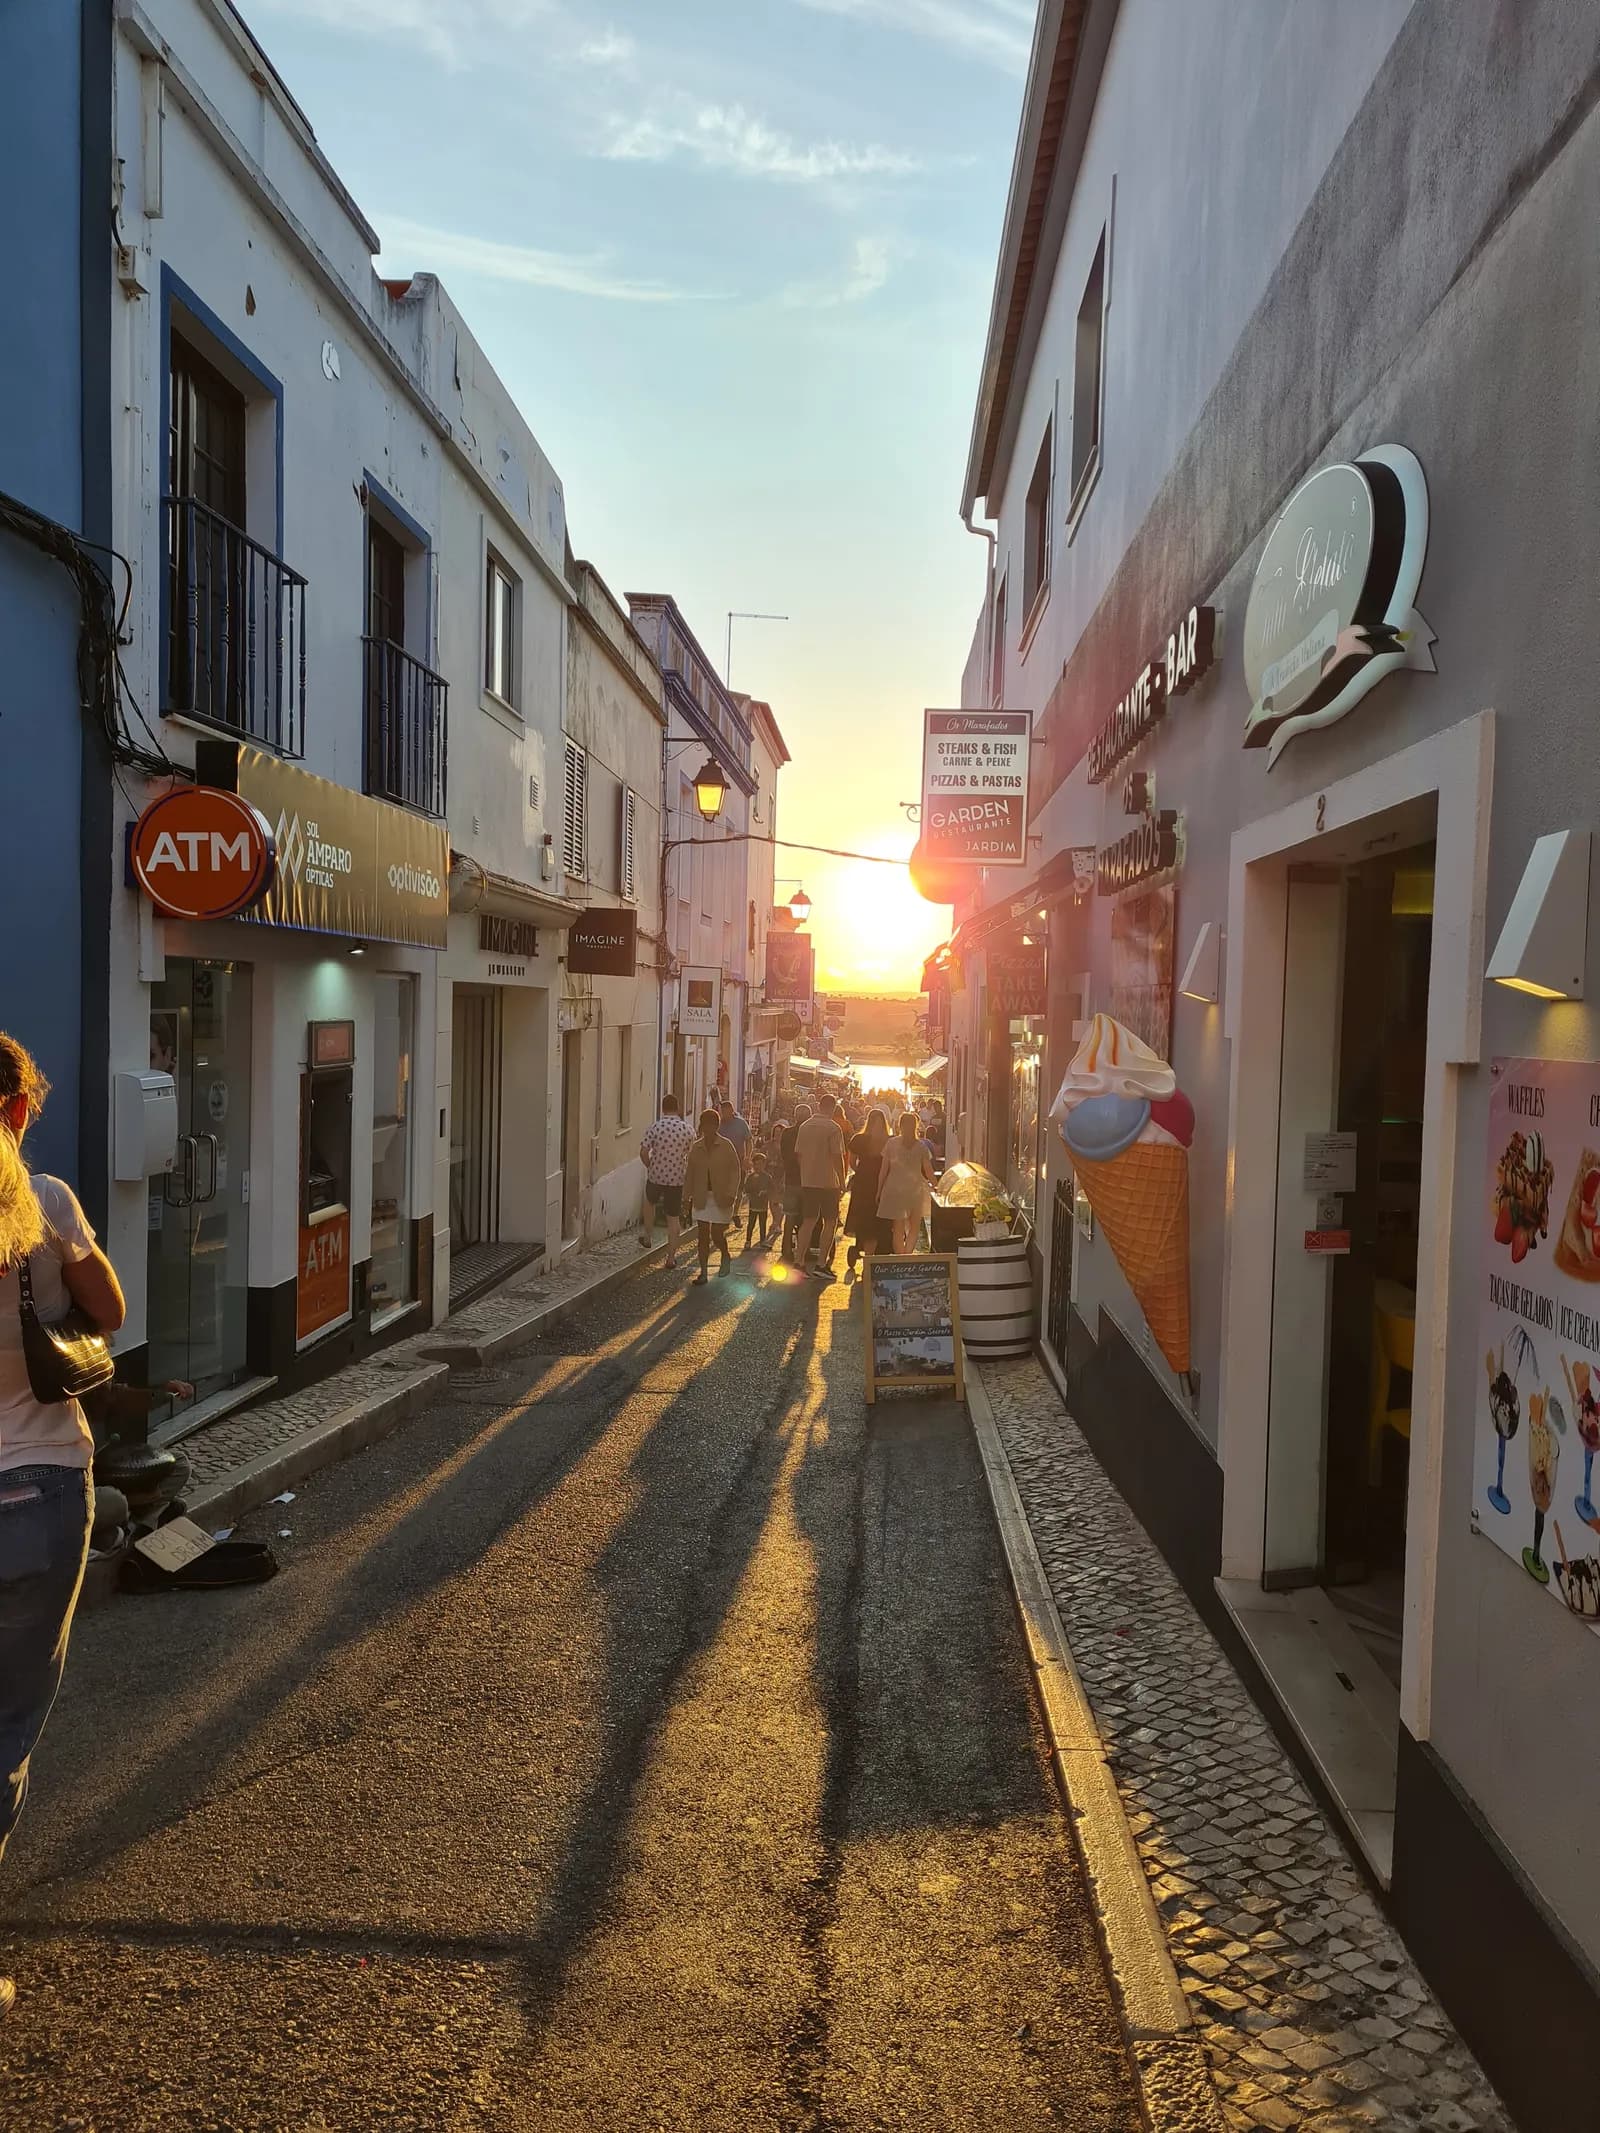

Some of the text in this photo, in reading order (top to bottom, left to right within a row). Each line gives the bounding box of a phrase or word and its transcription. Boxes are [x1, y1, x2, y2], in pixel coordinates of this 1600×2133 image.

[1088, 605, 1200, 781] RESTAURANTE BAR
[937, 743, 1017, 756] STEAKS & FISH
[942, 757, 1012, 767] CARNE & PEIXE
[930, 774, 1022, 788] PIZZAS & PASTAS
[931, 799, 1010, 829] GARDEN
[306, 820, 320, 839] SOL
[145, 831, 250, 872] ATM
[306, 839, 352, 875] AMPARO
[964, 840, 1017, 853] JARDIM
[305, 864, 334, 889] ÓPTICAS
[575, 933, 625, 946] IMAGINE
[991, 975, 1039, 992] TAKE
[991, 994, 1041, 1012] AWAY
[1508, 1084, 1545, 1119] WAFFLES
[305, 1227, 343, 1280] ATM
[1489, 1273, 1509, 1312] TAÇAS
[1510, 1282, 1521, 1315] DE
[1520, 1287, 1554, 1331] GELADOS
[1560, 1304, 1574, 1340] ICE
